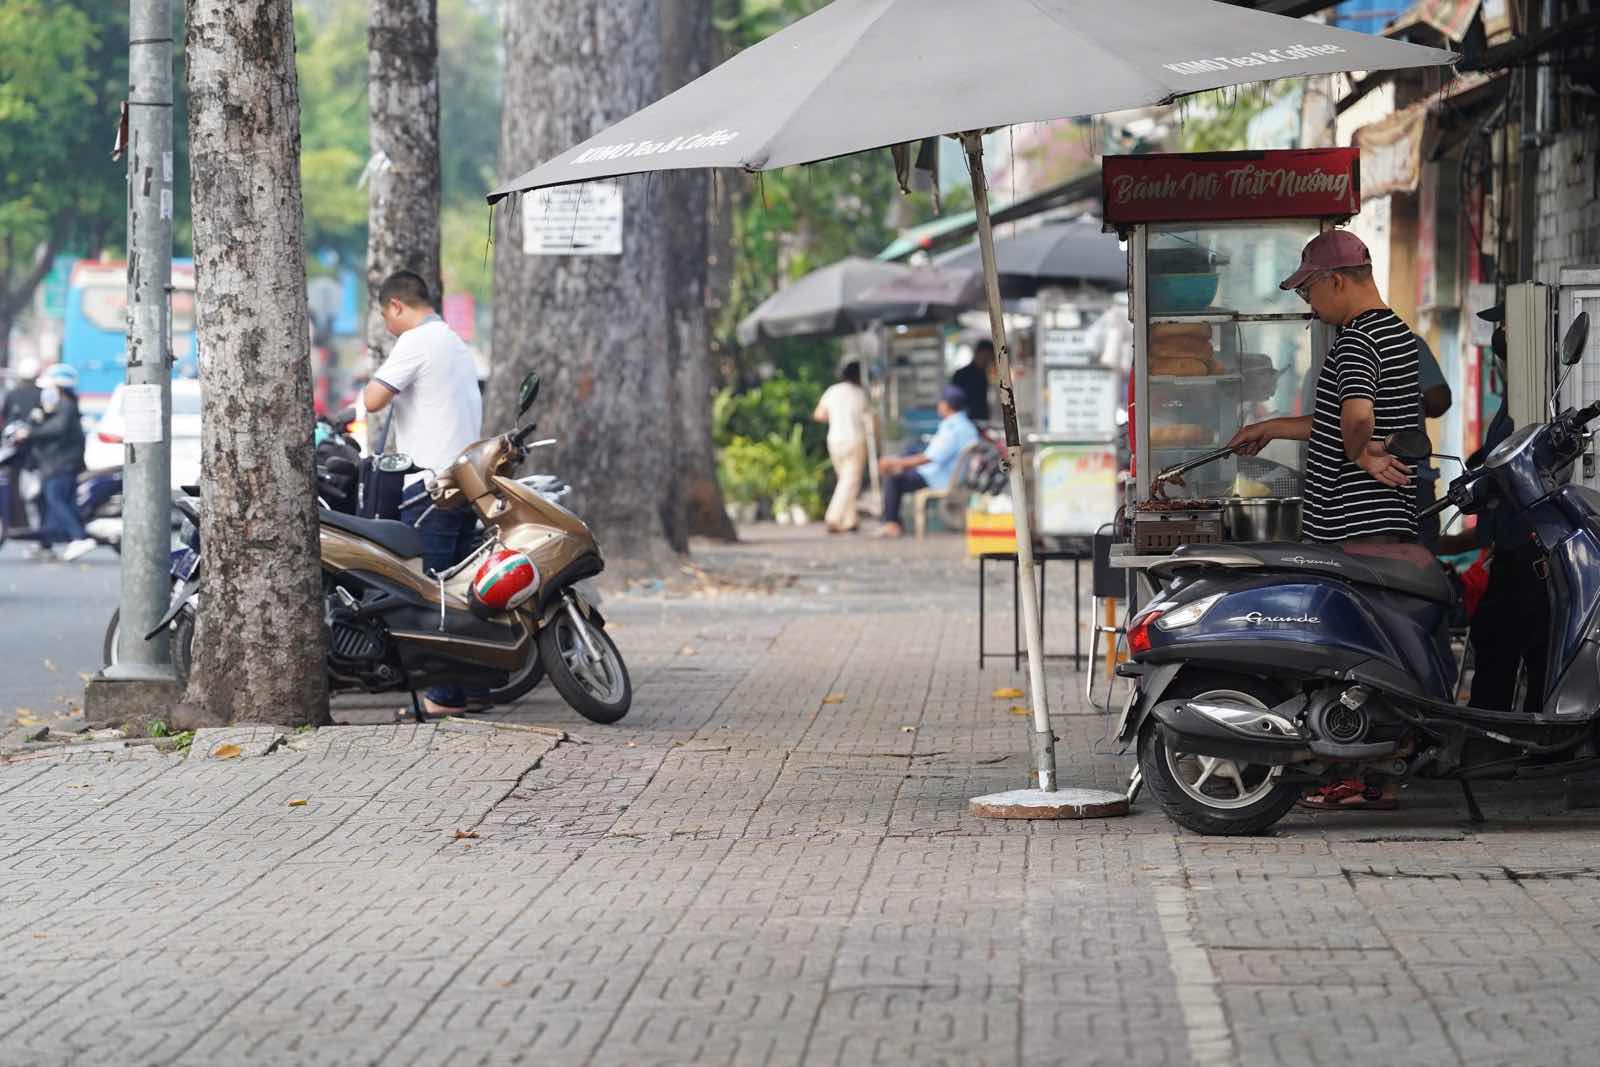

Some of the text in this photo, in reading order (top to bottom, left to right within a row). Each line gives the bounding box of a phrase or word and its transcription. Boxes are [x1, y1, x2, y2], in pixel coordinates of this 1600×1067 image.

[1269, 44, 1346, 60] Coffee
[1112, 172, 1178, 204] Bánh
[1224, 164, 1272, 200] Thịt
[1281, 555, 1342, 568] Grande
[1227, 611, 1320, 625] Grande
